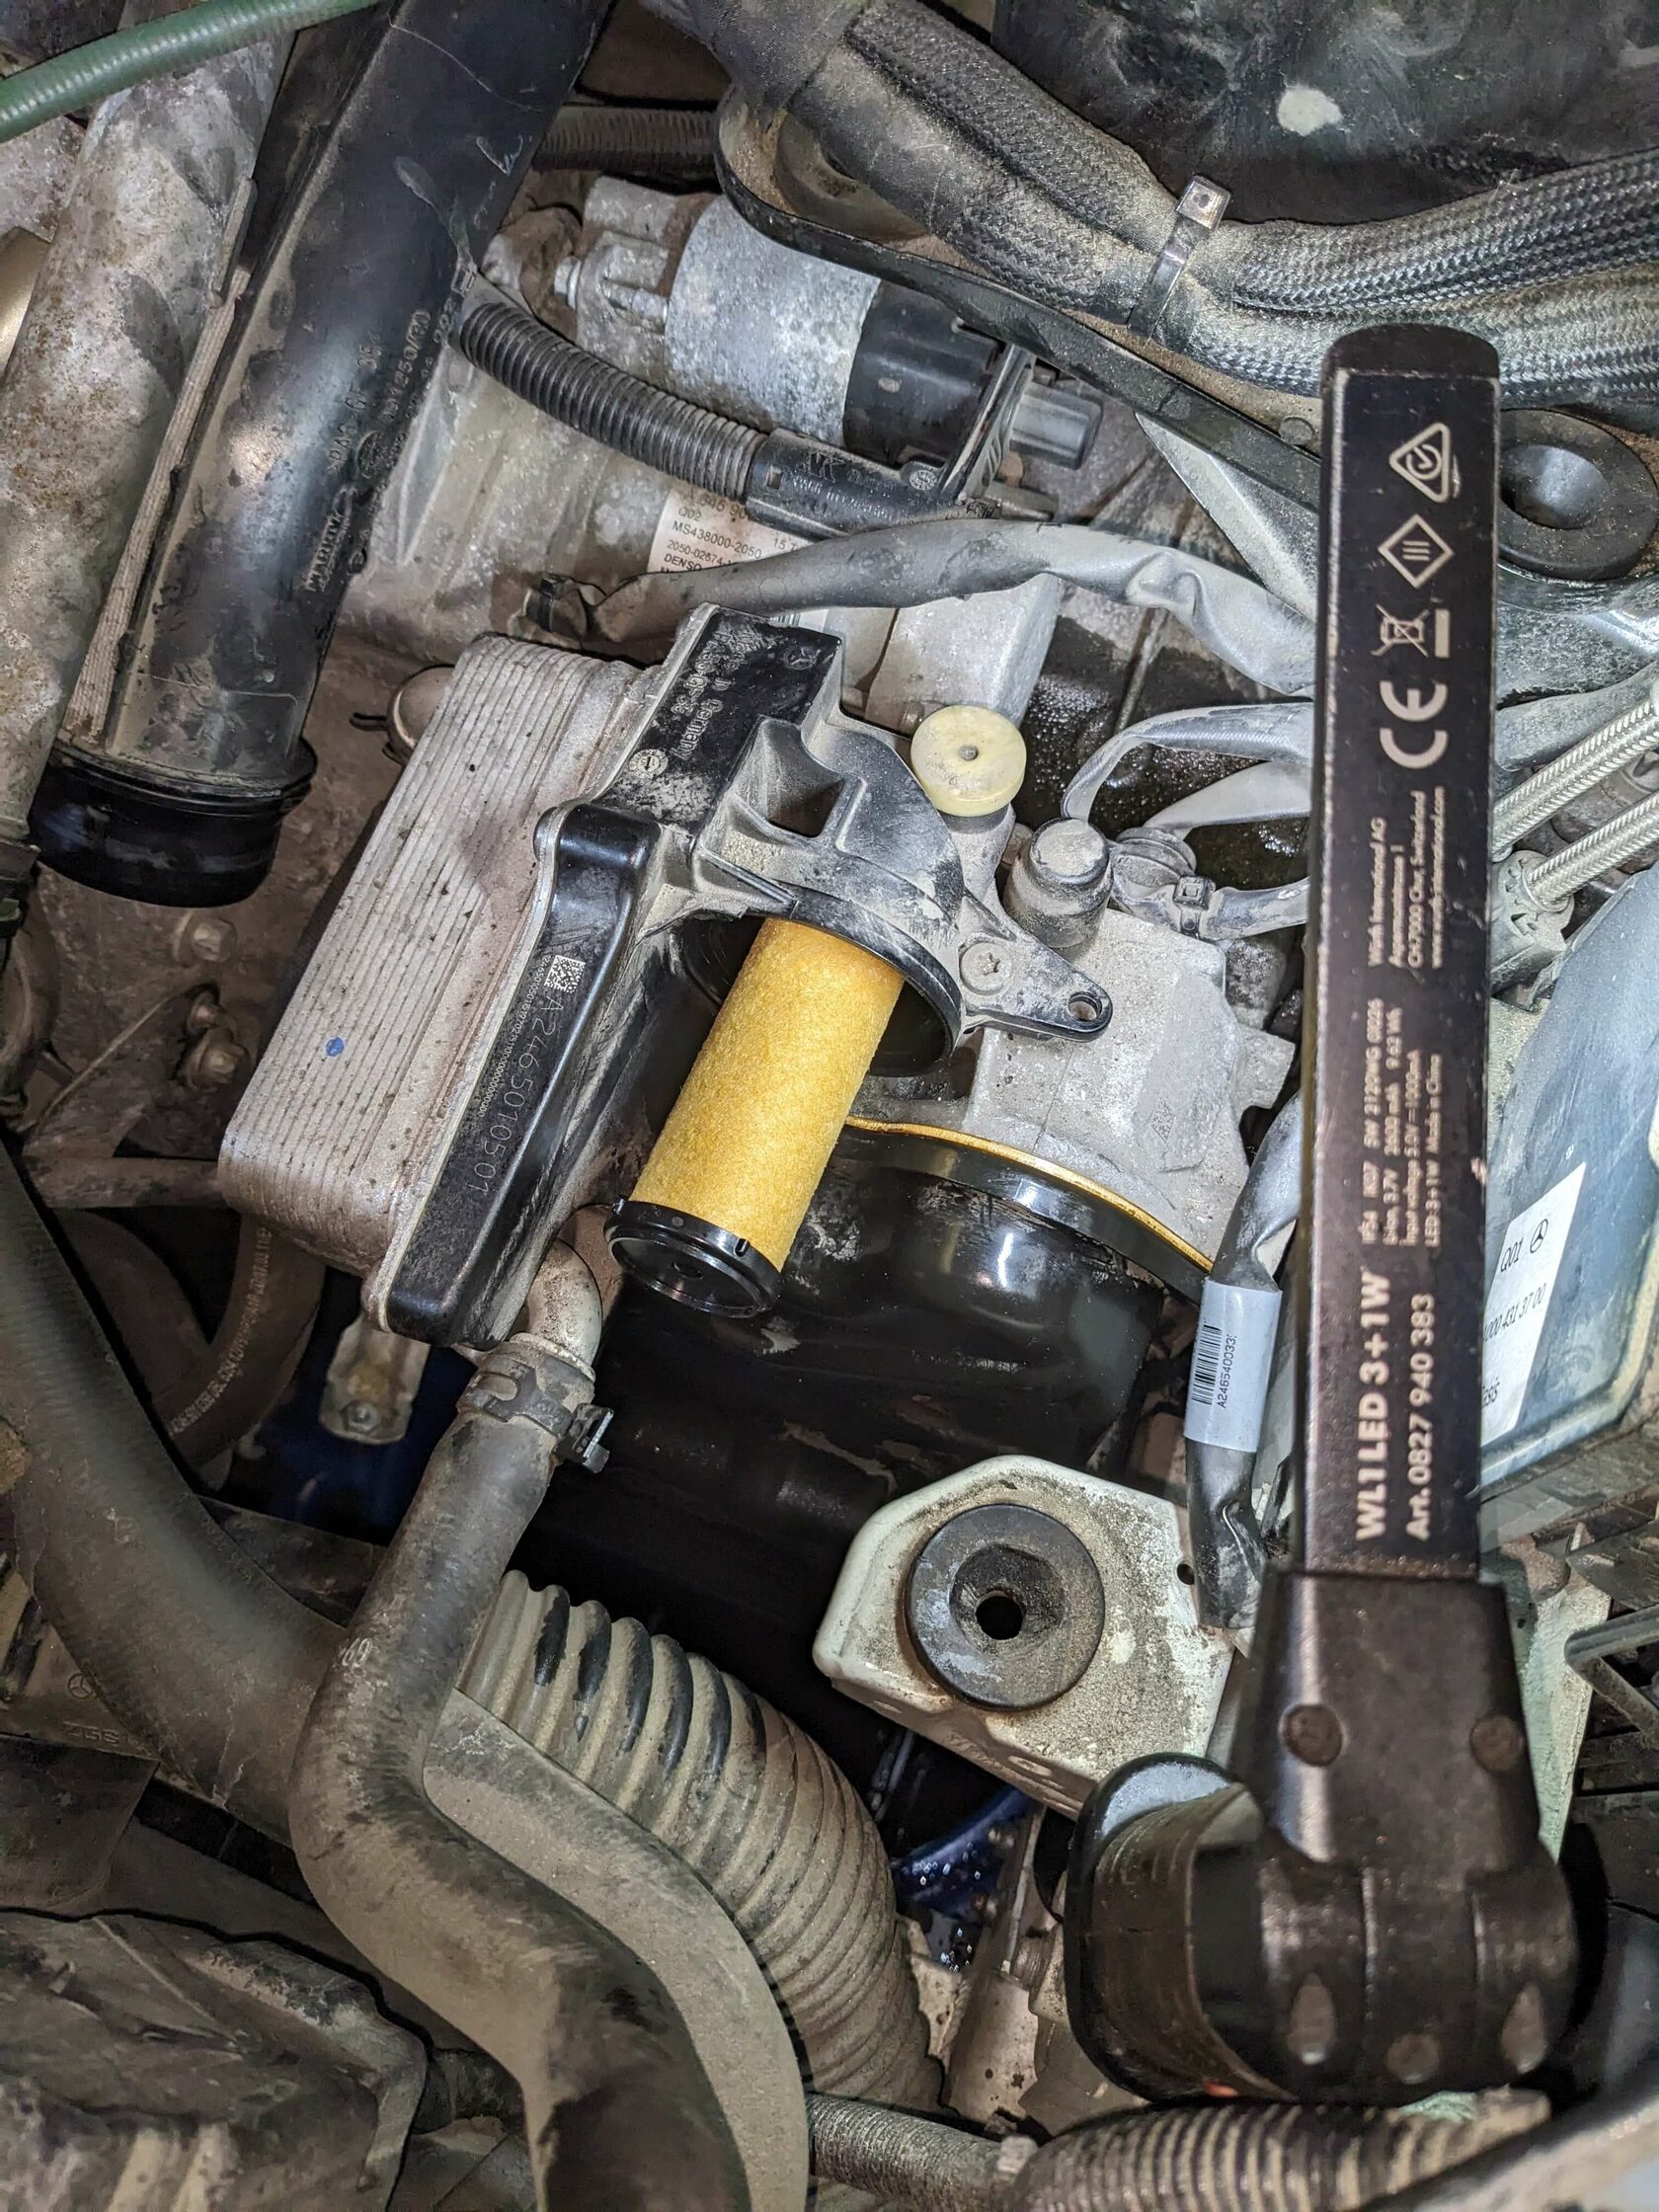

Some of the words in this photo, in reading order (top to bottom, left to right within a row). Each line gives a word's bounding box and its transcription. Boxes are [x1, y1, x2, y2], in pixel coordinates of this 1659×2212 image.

[664, 553, 702, 571] DENSO
[672, 520, 762, 560] MS438000-2050
[670, 698, 724, 760] Germany
[1380, 680, 1449, 769] CE
[1371, 817, 1387, 842] AG
[1500, 1236, 1523, 1273] Q01
[1410, 1293, 1435, 1346] 383
[1216, 1333, 1237, 1410] A246540033
[1409, 1352, 1434, 1406] 940
[1358, 1392, 1389, 1462] LED
[1407, 1413, 1433, 1485] 0827
[1405, 1487, 1432, 1540] Art.
